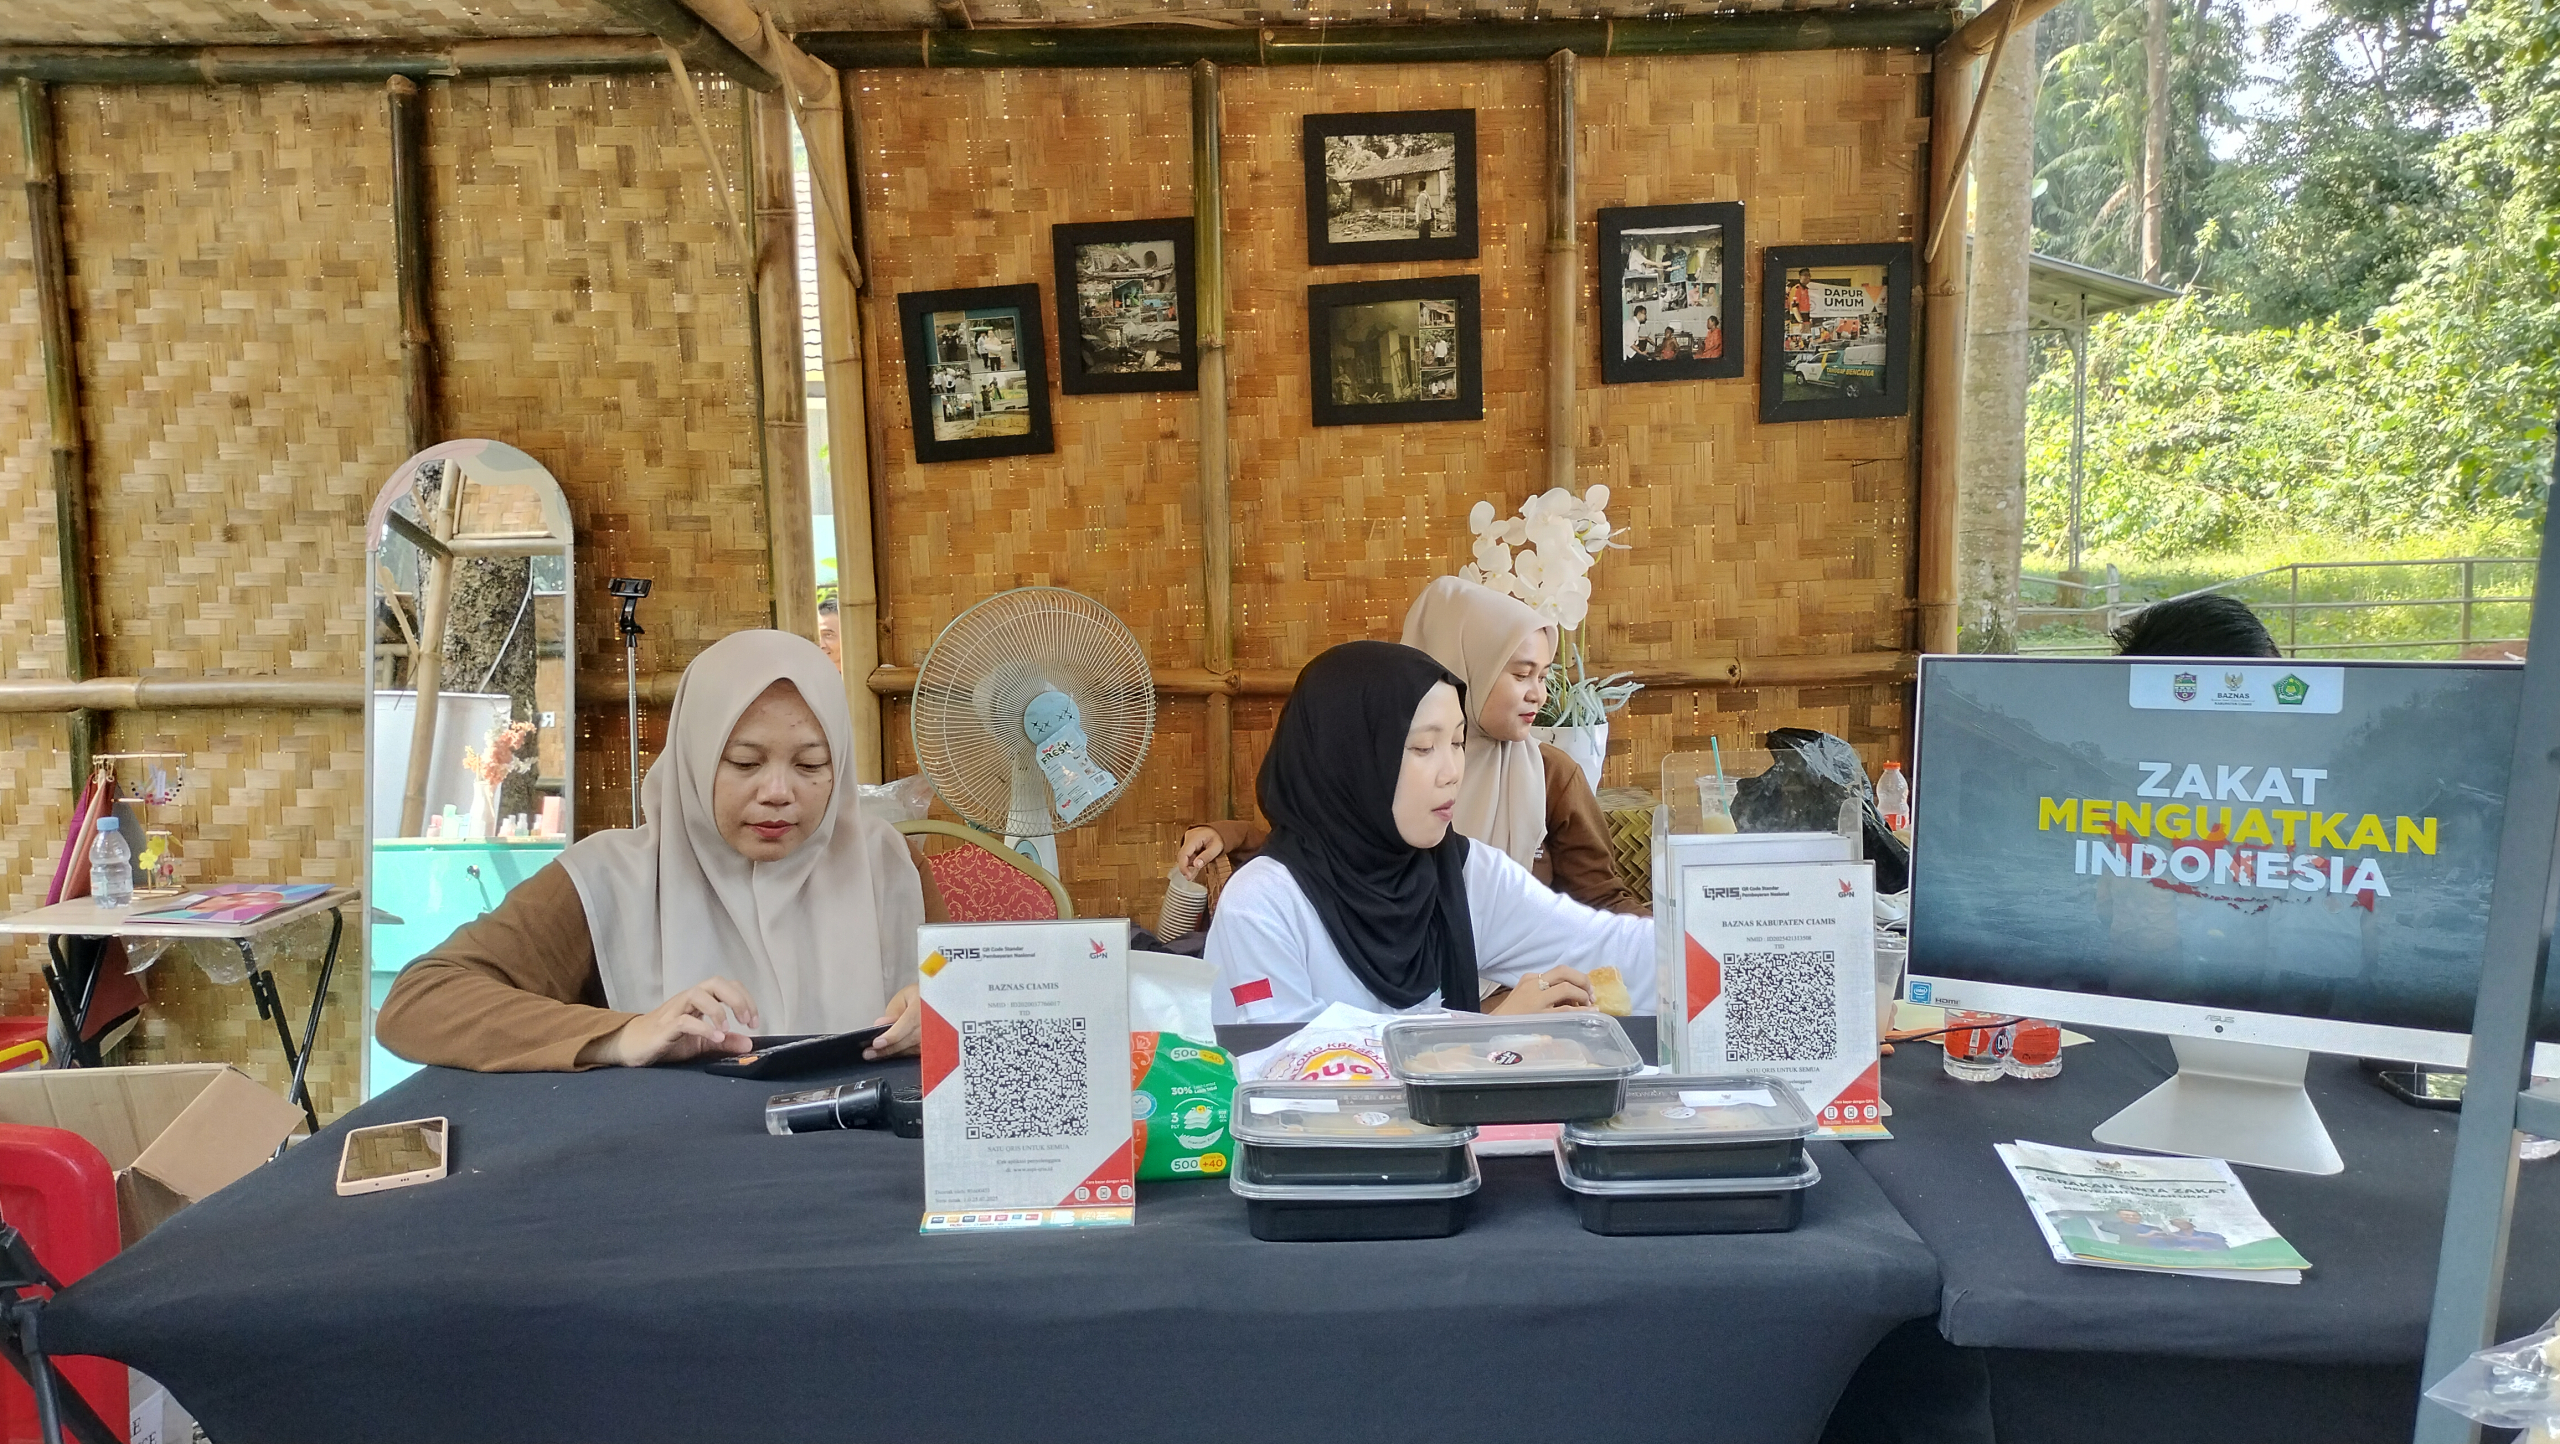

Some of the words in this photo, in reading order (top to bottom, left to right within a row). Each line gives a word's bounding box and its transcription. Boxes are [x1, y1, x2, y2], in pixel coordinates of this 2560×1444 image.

[1824, 288, 1863, 298] DAPUR
[1824, 297, 1864, 307] UMUM
[1041, 741, 1071, 765] FRESH
[2136, 761, 2328, 805] ZAKAT
[2038, 796, 2438, 855] MENGUATKAN
[2074, 839, 2392, 897] INDONESIA
[1704, 886, 1741, 900] QRIS
[1756, 919, 1804, 927] KABUPATEN
[940, 947, 981, 962] QRIS
[988, 983, 1025, 991] BAZNAS
[1026, 982, 1059, 990] CIAMIS
[2204, 1014, 2235, 1023] ASUS
[1173, 1049, 1198, 1059] 500
[1327, 1041, 1383, 1061] KRESEK
[1171, 1086, 1193, 1096] 30%
[1171, 1112, 1179, 1123] 3
[1174, 1159, 1198, 1170] 500
[1202, 1159, 1223, 1168] +40
[2036, 1175, 2115, 1189] GERAKAN
[2118, 1184, 2169, 1194] CINTA
